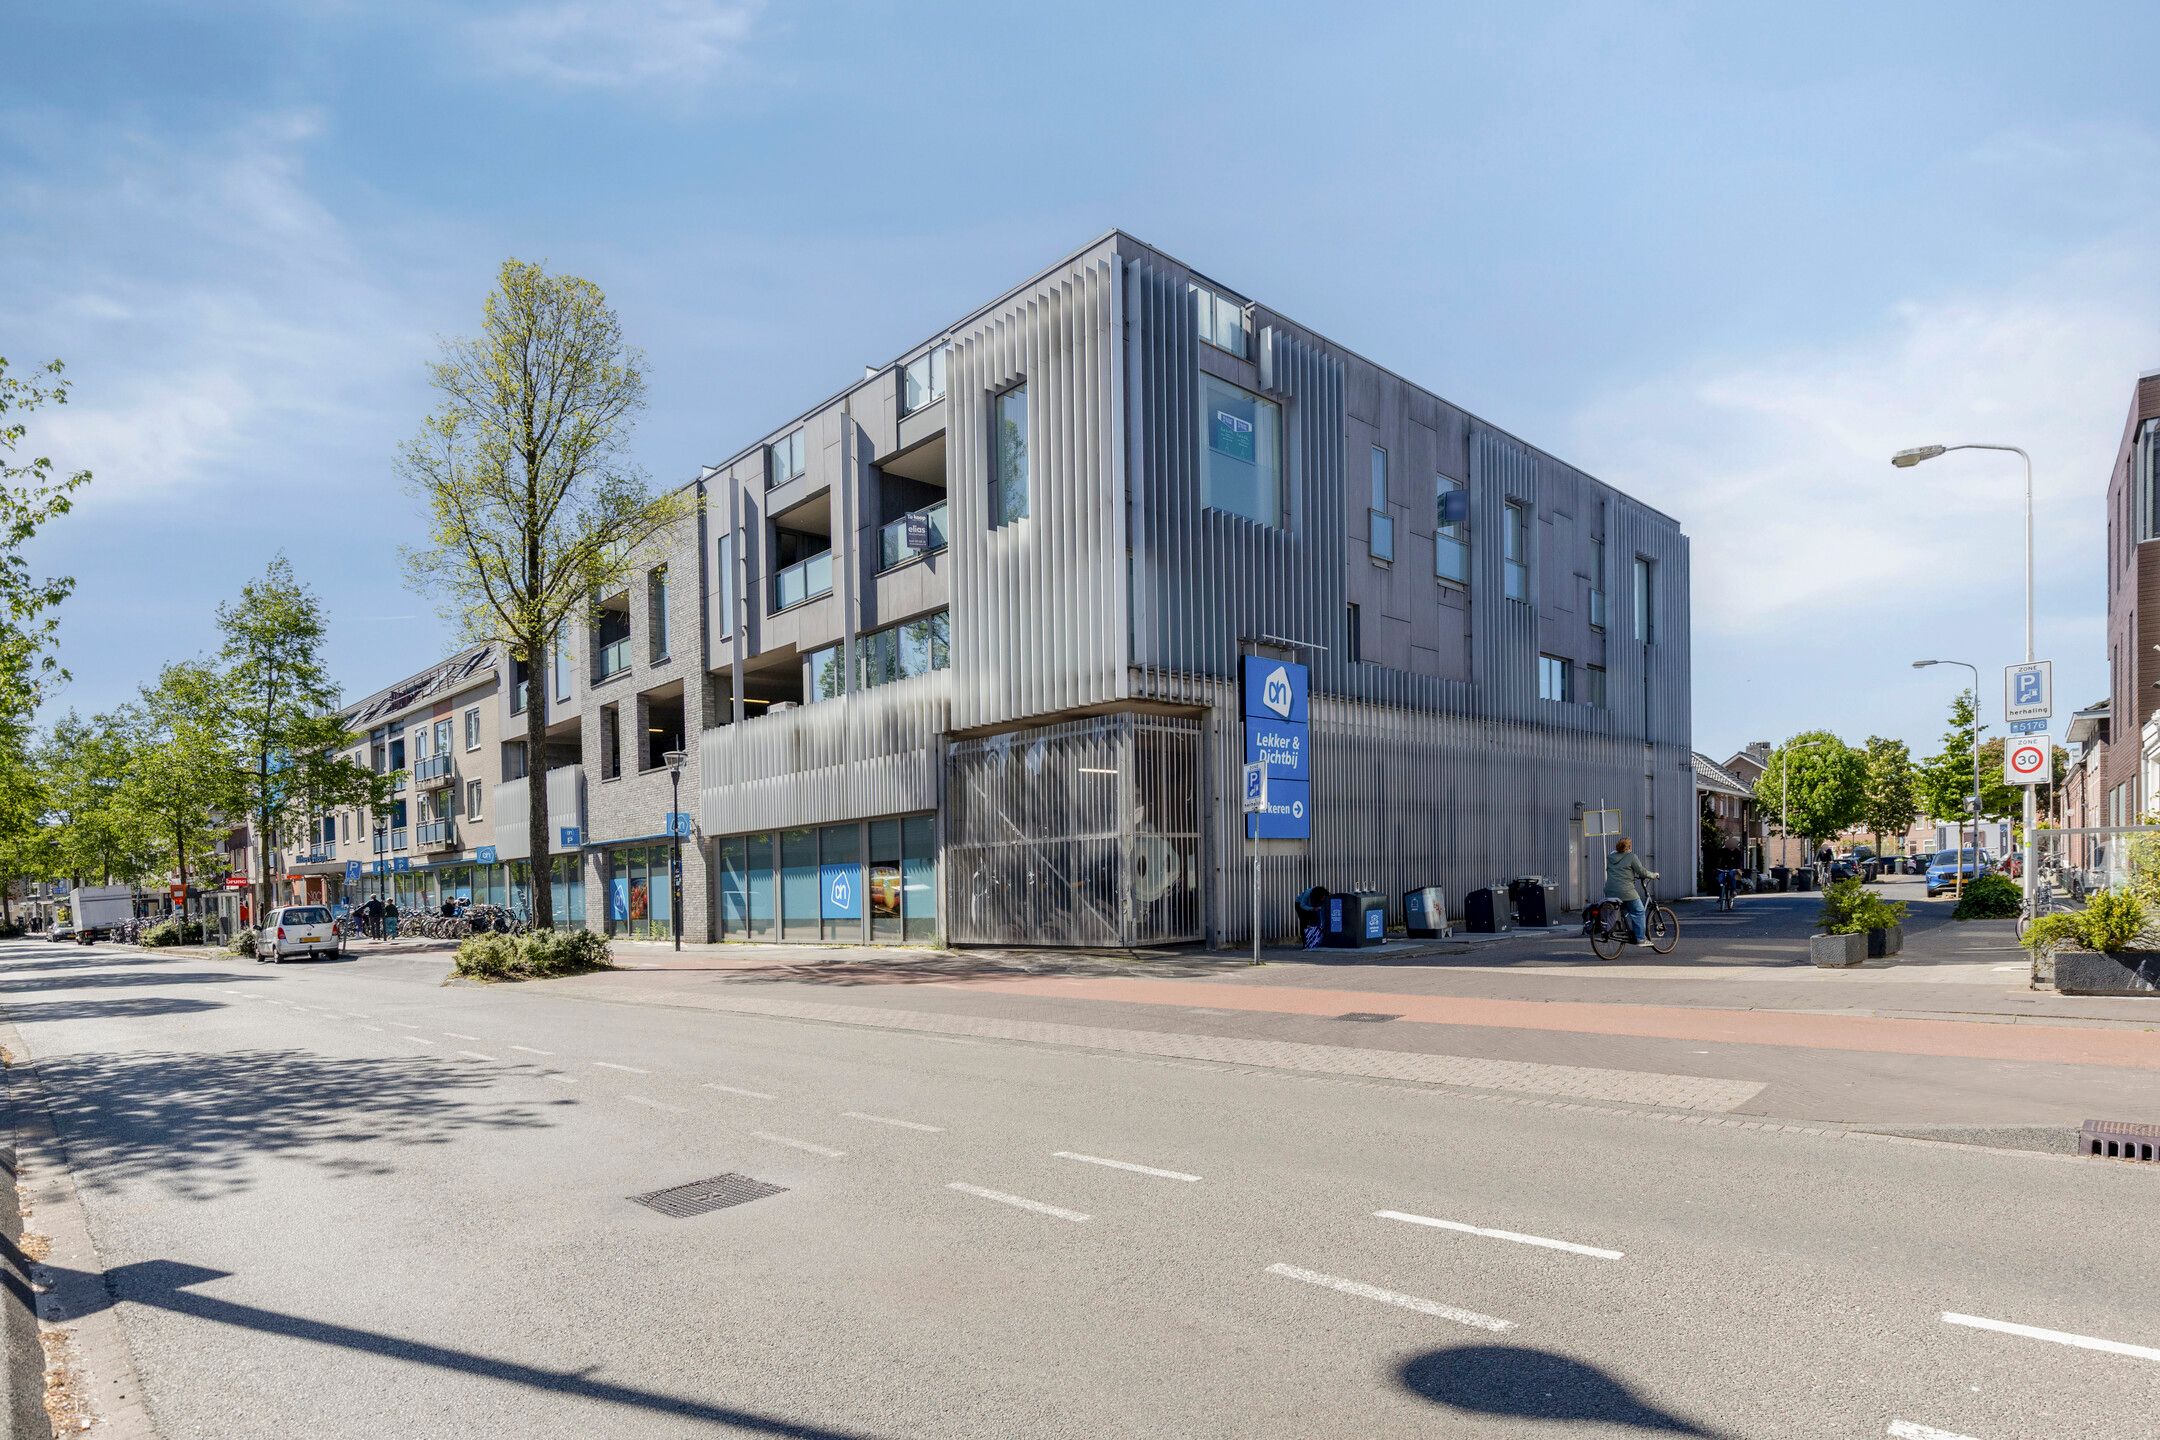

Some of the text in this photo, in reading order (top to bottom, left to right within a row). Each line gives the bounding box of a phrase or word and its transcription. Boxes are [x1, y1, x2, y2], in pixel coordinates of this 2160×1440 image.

[908, 525, 926, 533] elias
[2020, 674, 2036, 692] P
[2009, 706, 2048, 716] herhaling
[2019, 721, 2046, 731] 5176
[1256, 732, 1300, 750] Lekker &
[1259, 749, 1299, 770] Dichtbij
[2017, 754, 2038, 766] 30
[1250, 772, 1258, 788] P
[1260, 801, 1291, 814] keren
[350, 861, 359, 872] P
